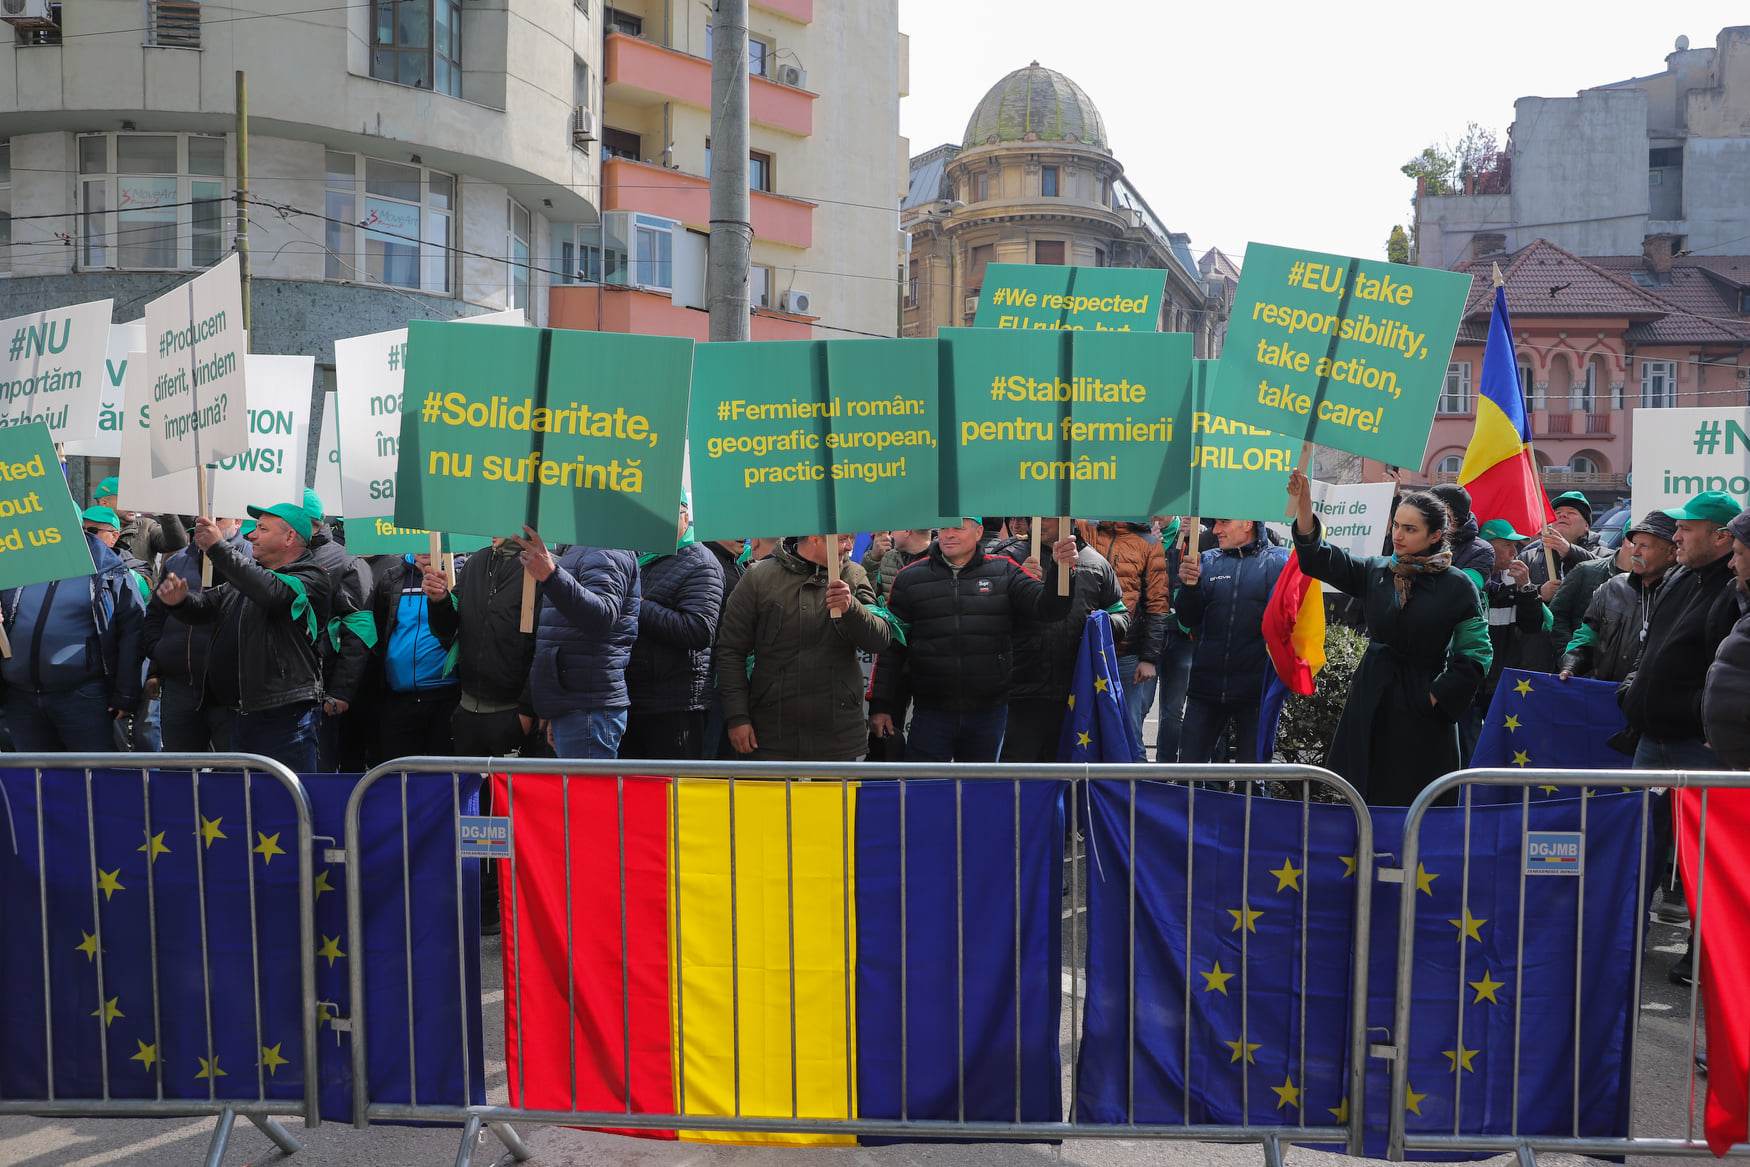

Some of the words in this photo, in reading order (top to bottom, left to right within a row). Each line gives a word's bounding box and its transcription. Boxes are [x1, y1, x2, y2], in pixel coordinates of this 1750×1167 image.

[1288, 261, 1345, 300] #EU,
[1355, 271, 1414, 306] take
[993, 287, 1038, 308] #We
[1041, 291, 1149, 315] respected
[9, 318, 72, 362] #NU
[159, 309, 226, 359] #Producem
[1252, 301, 1428, 360] responsibility,
[154, 366, 190, 403] diferit,
[192, 351, 236, 388] vindem
[1256, 338, 1310, 373] take
[1315, 356, 1402, 400] action,
[990, 375, 1147, 404] #Stabilitate
[163, 392, 228, 442] împreună?
[422, 391, 659, 448] #Solidaritate,
[717, 396, 841, 421] #Fermierul
[847, 394, 926, 417] român:
[1257, 379, 1311, 415] take
[1317, 399, 1384, 434] care!
[247, 409, 294, 435] ION
[961, 416, 1054, 446] pentru
[1060, 416, 1173, 442] fermierii
[707, 429, 820, 459] geografic
[825, 427, 938, 451] european,
[206, 447, 284, 474] OWS!
[428, 450, 473, 478] nu
[744, 460, 825, 488] practic
[831, 456, 907, 483] singur!
[1018, 454, 1117, 481] români
[1349, 501, 1368, 515] de
[28, 527, 62, 548] us
[1326, 522, 1372, 542] pentru
[461, 825, 507, 839] DGJMB
[1529, 842, 1578, 856] DGJMB
